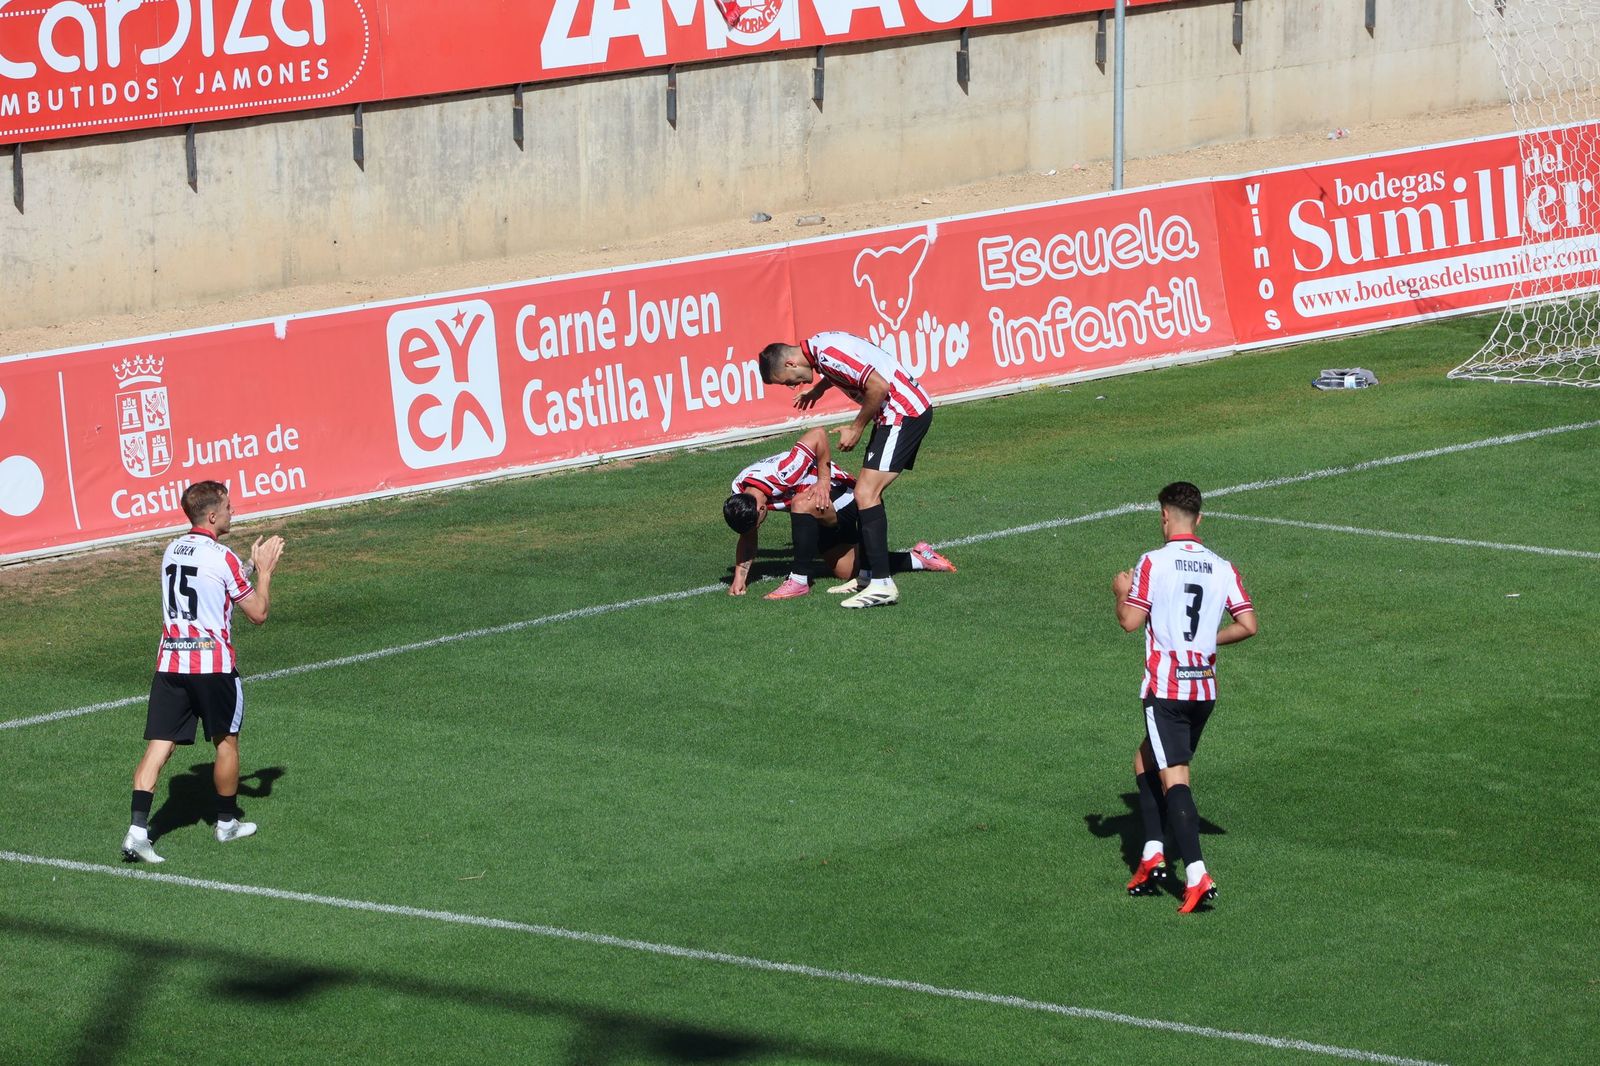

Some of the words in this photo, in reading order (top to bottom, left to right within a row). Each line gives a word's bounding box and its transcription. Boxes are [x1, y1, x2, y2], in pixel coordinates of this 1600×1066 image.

[172, 76, 183, 95] Y
[195, 58, 329, 94] JAMONES
[1334, 170, 1446, 207] bodegas
[1525, 144, 1564, 176] del
[978, 207, 1200, 291] Escuela
[1288, 165, 1594, 272] Sumiller
[1299, 247, 1598, 311] www.bodegasdelsumiller.com
[515, 291, 617, 362] Carné
[624, 289, 721, 346] Joven
[988, 276, 1211, 368] infantil
[523, 363, 649, 436] Castilla
[654, 375, 673, 433] y
[680, 346, 764, 411] León
[182, 434, 257, 468] Junta
[266, 424, 299, 453] de
[111, 480, 190, 519] Castil
[239, 463, 306, 499] León
[173, 544, 197, 557] LOREN
[165, 563, 199, 622] 15
[1183, 583, 1204, 642] 3
